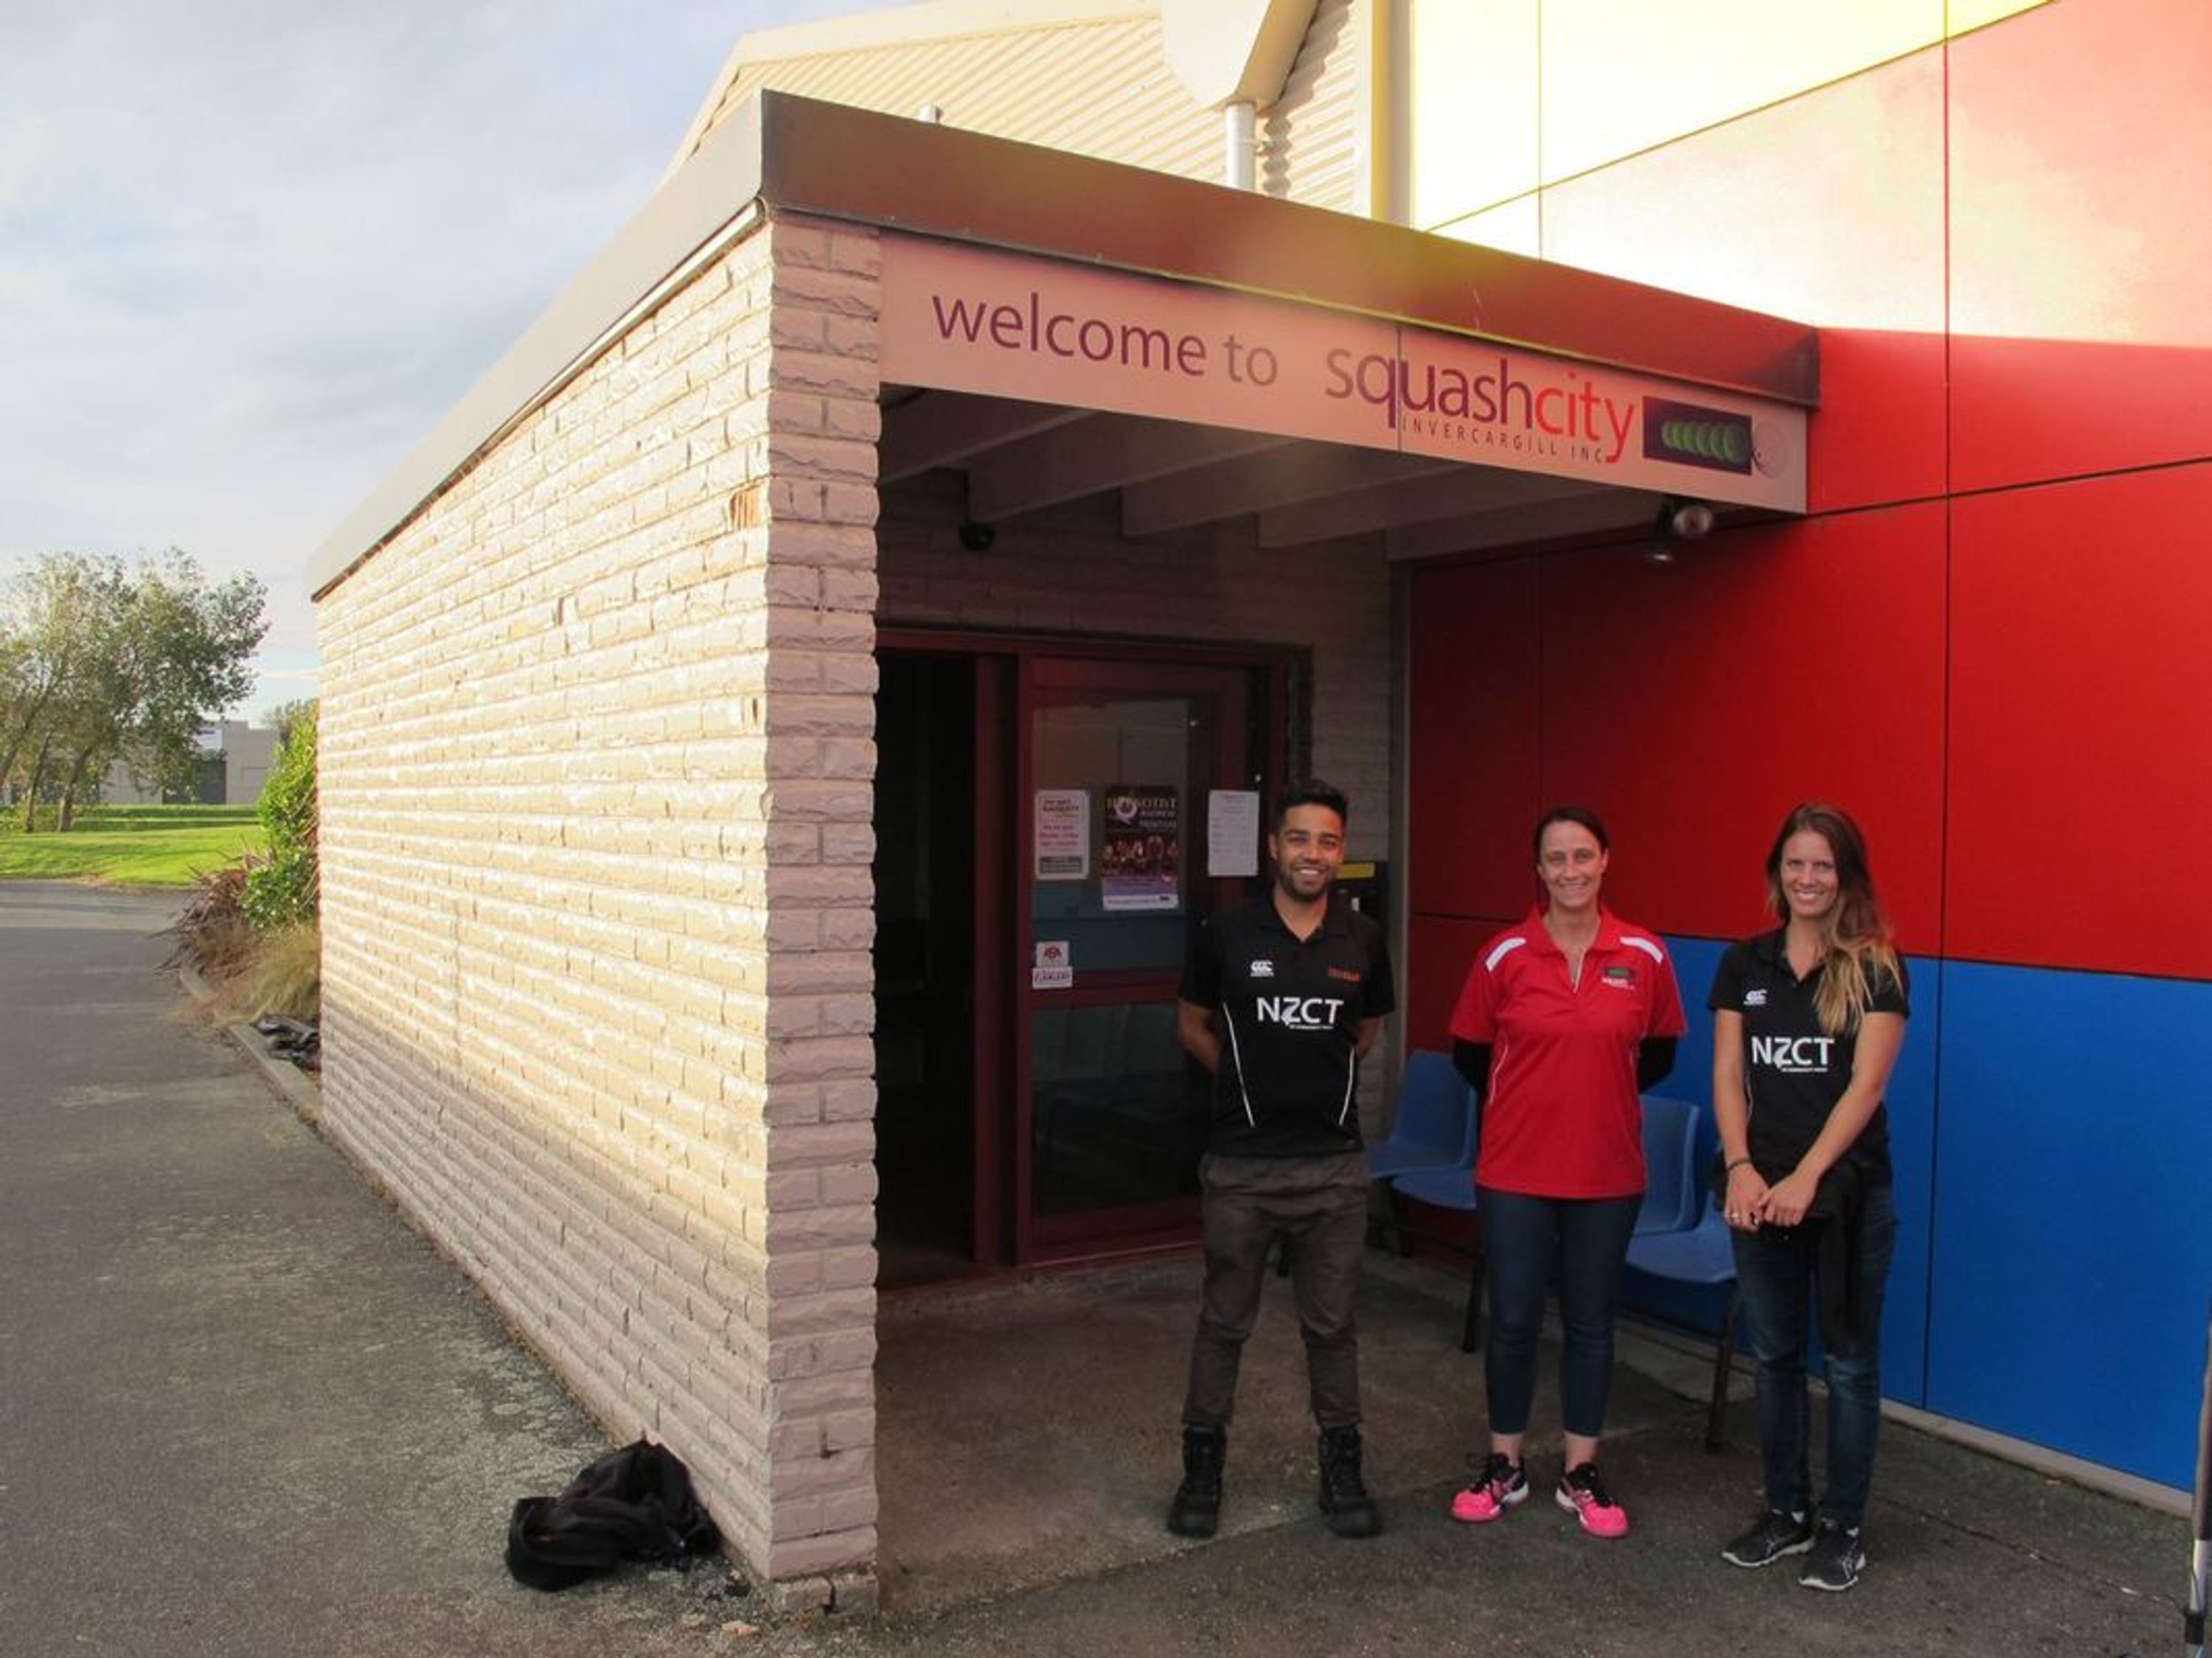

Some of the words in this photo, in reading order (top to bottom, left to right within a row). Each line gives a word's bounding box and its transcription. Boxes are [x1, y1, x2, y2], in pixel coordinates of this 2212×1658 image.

[932, 292, 1207, 377] welcome
[1222, 333, 1279, 388] to
[1325, 348, 1635, 463] squashcity
[1402, 416, 1558, 456] INVERCARGILL
[1256, 996, 1344, 1025] NZCT
[1751, 1036, 1834, 1067] NZCT
